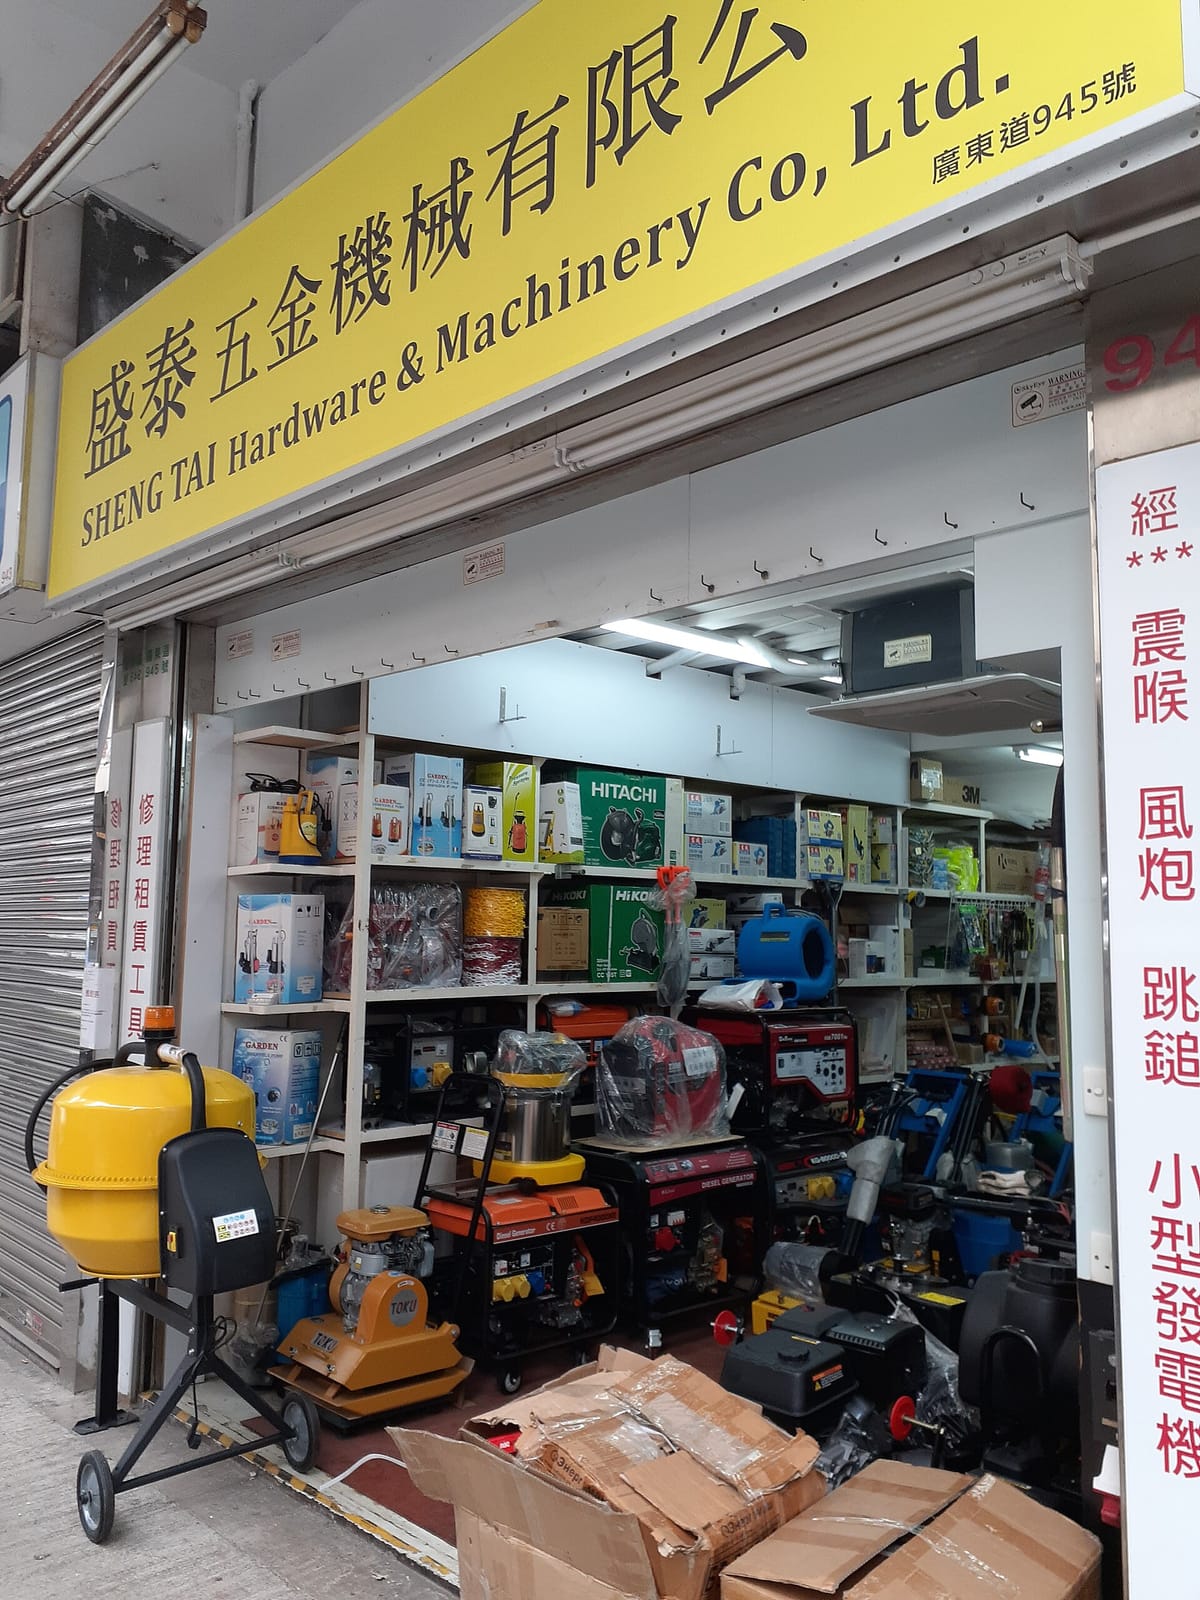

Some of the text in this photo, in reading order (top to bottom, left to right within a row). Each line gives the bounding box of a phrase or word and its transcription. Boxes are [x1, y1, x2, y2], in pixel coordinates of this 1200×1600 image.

[932, 61, 1137, 185] 廣東道945號
[81, 35, 1010, 547] SHENG TAI Hardware & Machinery Co, Ltd.
[1131, 486, 1178, 536] 經
[1132, 608, 1188, 724] 震喉
[591, 781, 657, 803] HITACHI
[962, 785, 980, 805] 3M
[1138, 785, 1195, 902] 風炮
[127, 793, 155, 1038] 修理租賃工具
[245, 1041, 279, 1050] GARDEN
[391, 1298, 418, 1315] TOKU
[313, 1331, 339, 1351] TOKU
